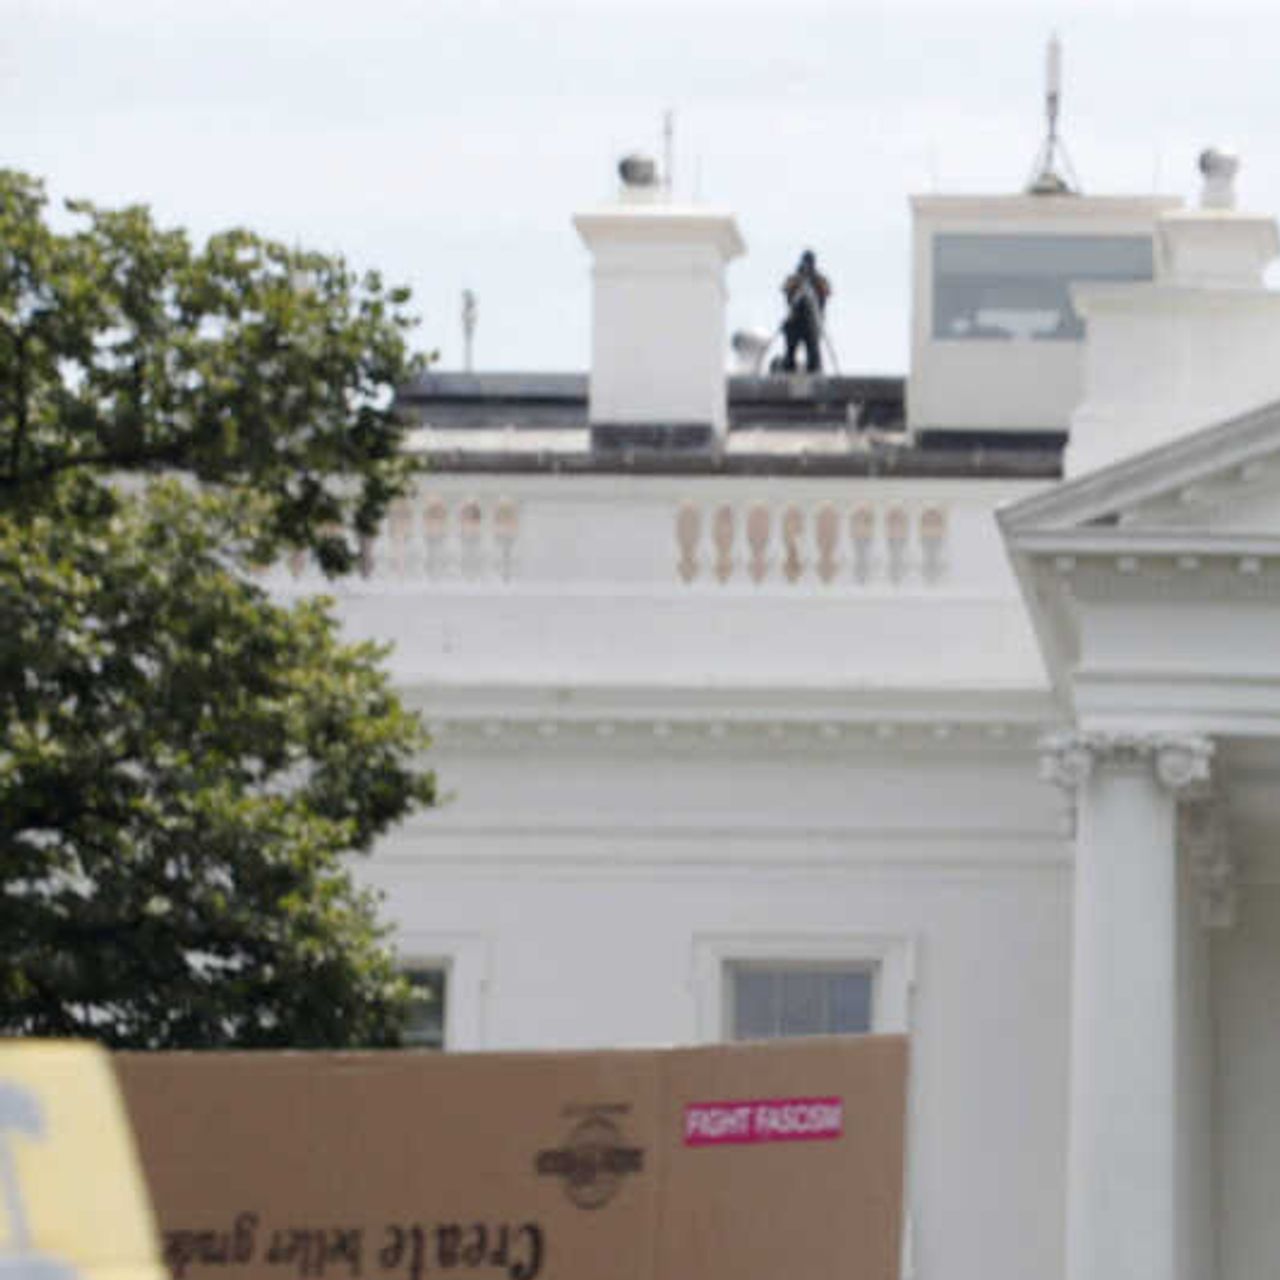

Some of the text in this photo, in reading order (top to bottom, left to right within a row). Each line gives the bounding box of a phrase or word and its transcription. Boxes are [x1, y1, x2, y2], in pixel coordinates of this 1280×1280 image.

[686, 1104, 843, 1137] FIGHT FASCISM
[264, 1227, 363, 1280] better
